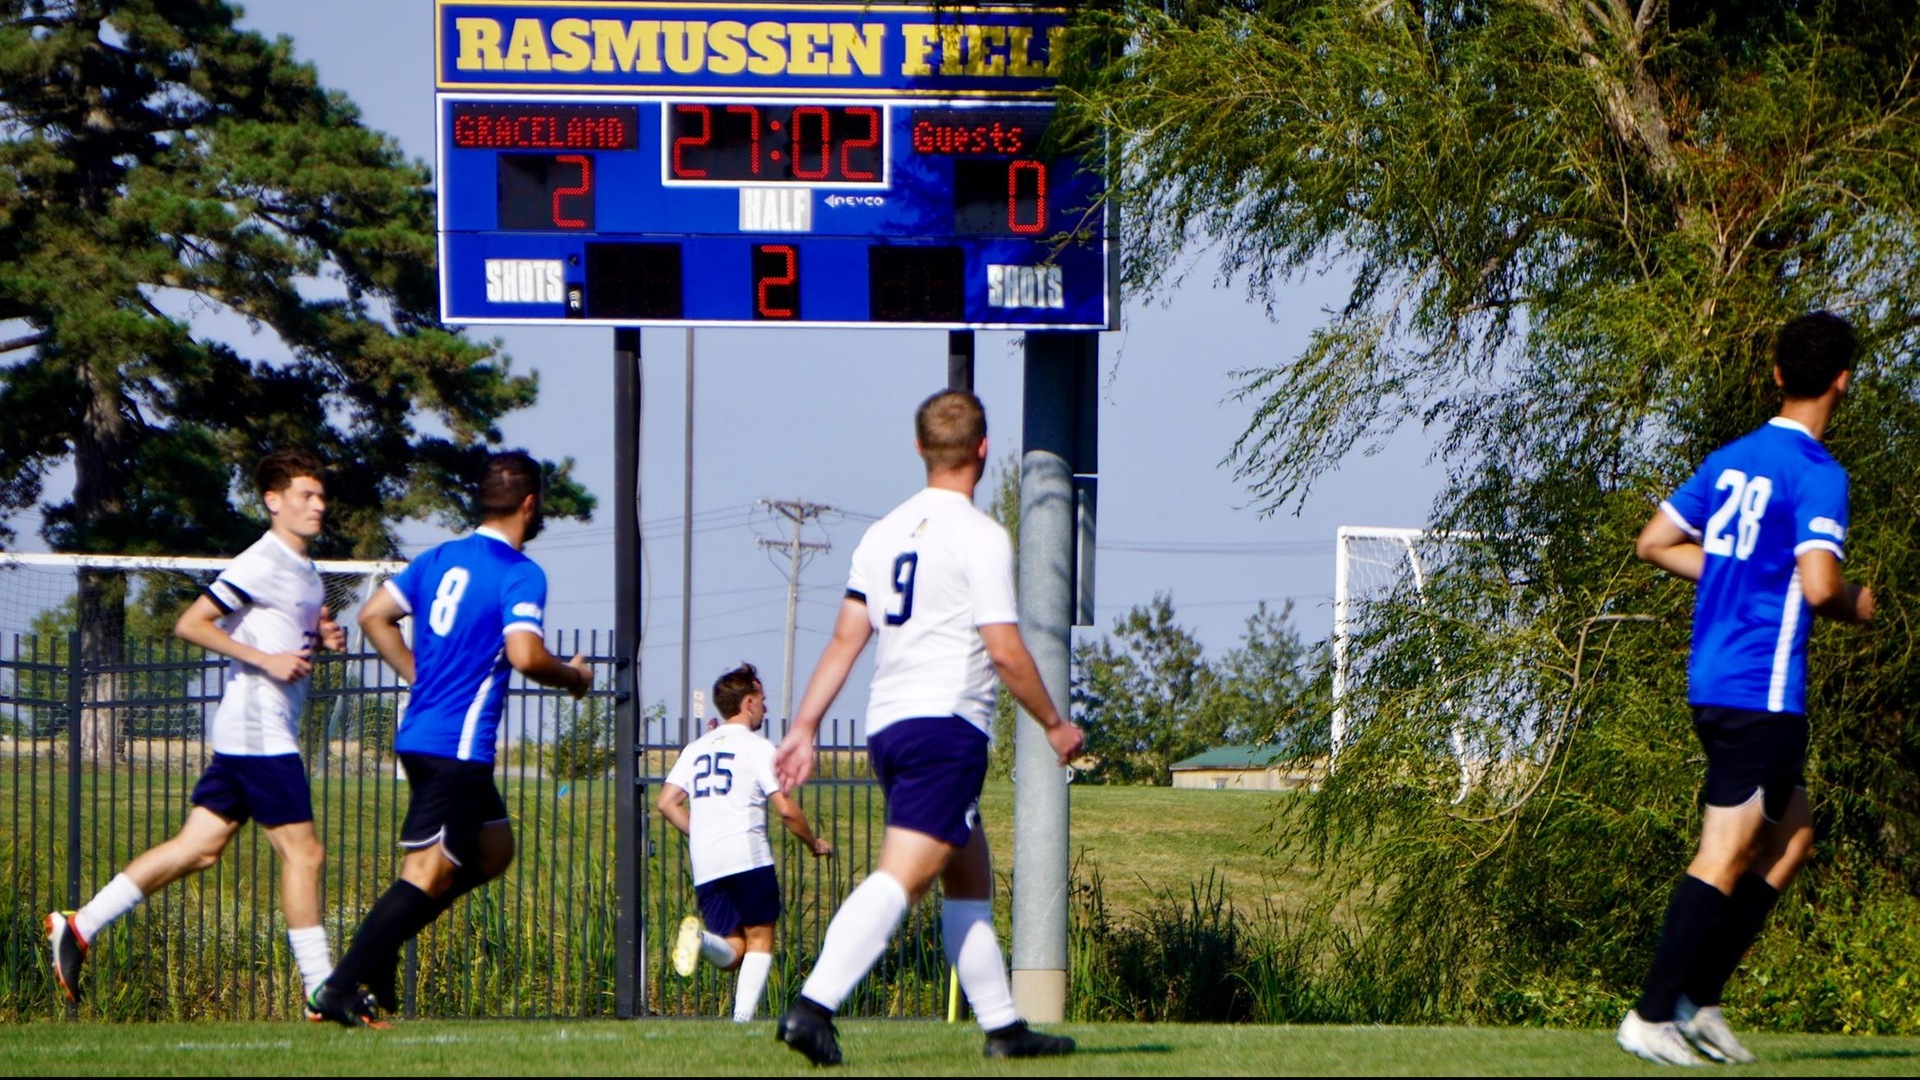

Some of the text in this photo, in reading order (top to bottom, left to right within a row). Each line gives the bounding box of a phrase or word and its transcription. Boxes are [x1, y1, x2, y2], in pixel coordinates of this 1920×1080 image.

[455, 17, 886, 75] RASMUSSEN
[455, 115, 624, 148] GRACELAND
[673, 104, 878, 180] 27:02
[913, 121, 1023, 153] Guests
[552, 154, 590, 228] 2
[743, 187, 810, 231] HALF
[1008, 160, 1046, 234] 0
[485, 259, 564, 303] SHOTS
[757, 245, 795, 317] 2
[987, 264, 1065, 309] SHOTS
[1703, 468, 1773, 561] 28
[429, 566, 470, 637] 8
[884, 550, 918, 626] 9
[693, 752, 736, 799] 25
